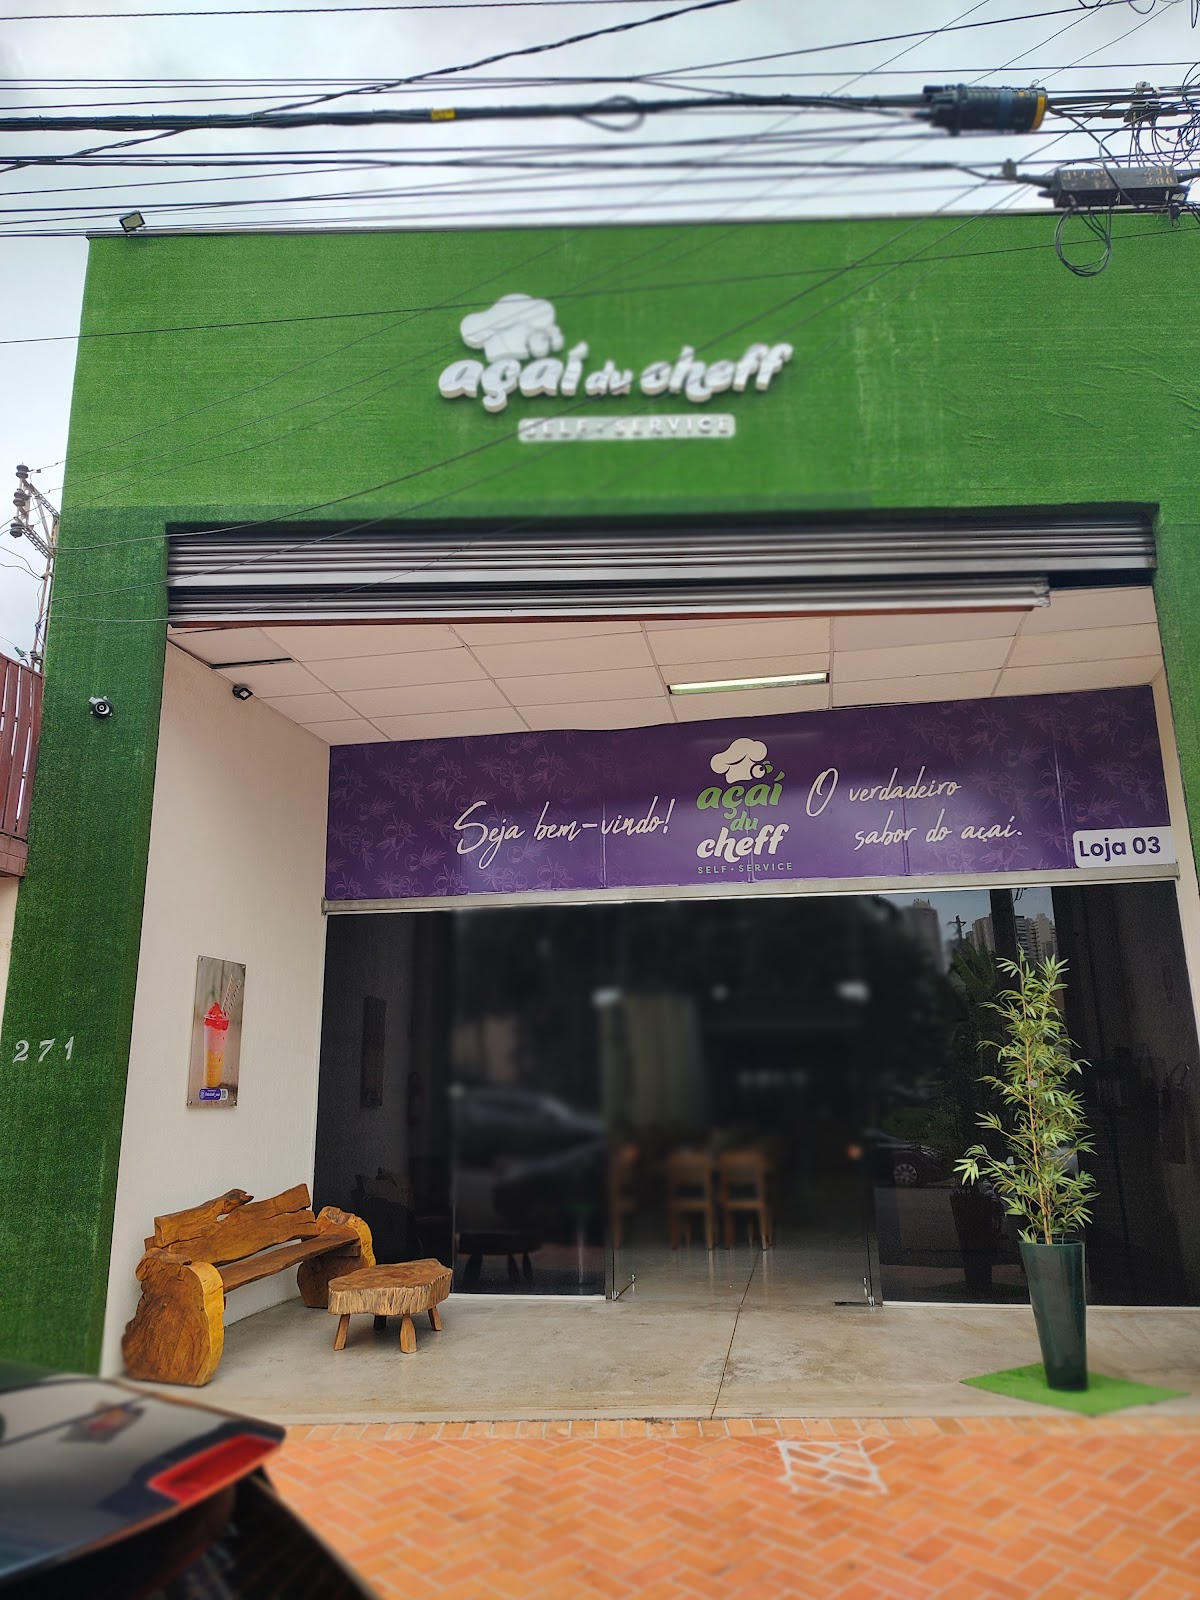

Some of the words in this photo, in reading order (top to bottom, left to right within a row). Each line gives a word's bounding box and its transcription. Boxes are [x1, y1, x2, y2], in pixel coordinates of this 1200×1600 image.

[438, 341, 589, 413] açaí
[585, 360, 633, 395] du
[640, 343, 794, 403] cheff
[696, 771, 786, 819] açaí
[805, 767, 840, 817] O
[848, 766, 962, 802] verdadeiro
[453, 800, 526, 870] Seja
[533, 795, 676, 842] bem-vindo!
[729, 810, 759, 832] du
[853, 810, 918, 851] sabor
[925, 809, 953, 843] do
[960, 815, 1024, 843] açaí.
[696, 823, 790, 863] cheff
[1079, 837, 1127, 862] Loja
[1132, 836, 1161, 855] 03
[12, 1035, 75, 1064] 271
